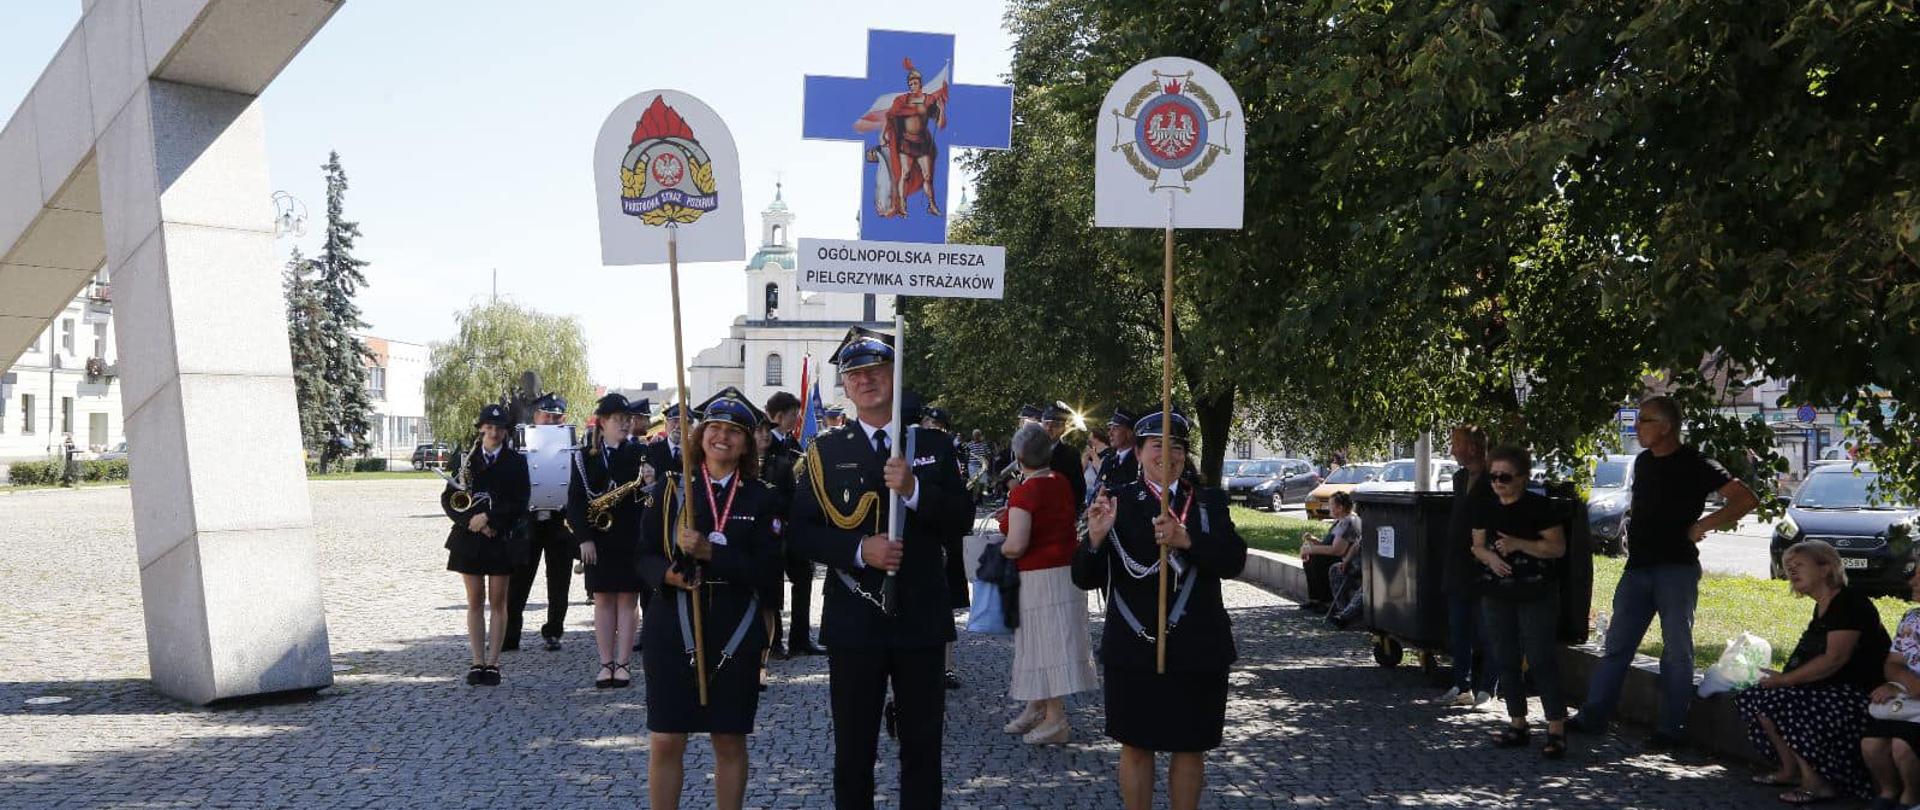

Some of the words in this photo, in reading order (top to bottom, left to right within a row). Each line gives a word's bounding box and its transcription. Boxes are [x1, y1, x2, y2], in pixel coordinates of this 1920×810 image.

[817, 245, 932, 264] OGÓLNOPOLSKA
[938, 252, 985, 266] PIESZA
[806, 270, 903, 287] PIELGRZYMKA
[909, 273, 994, 290] STRAŻAKÓW
